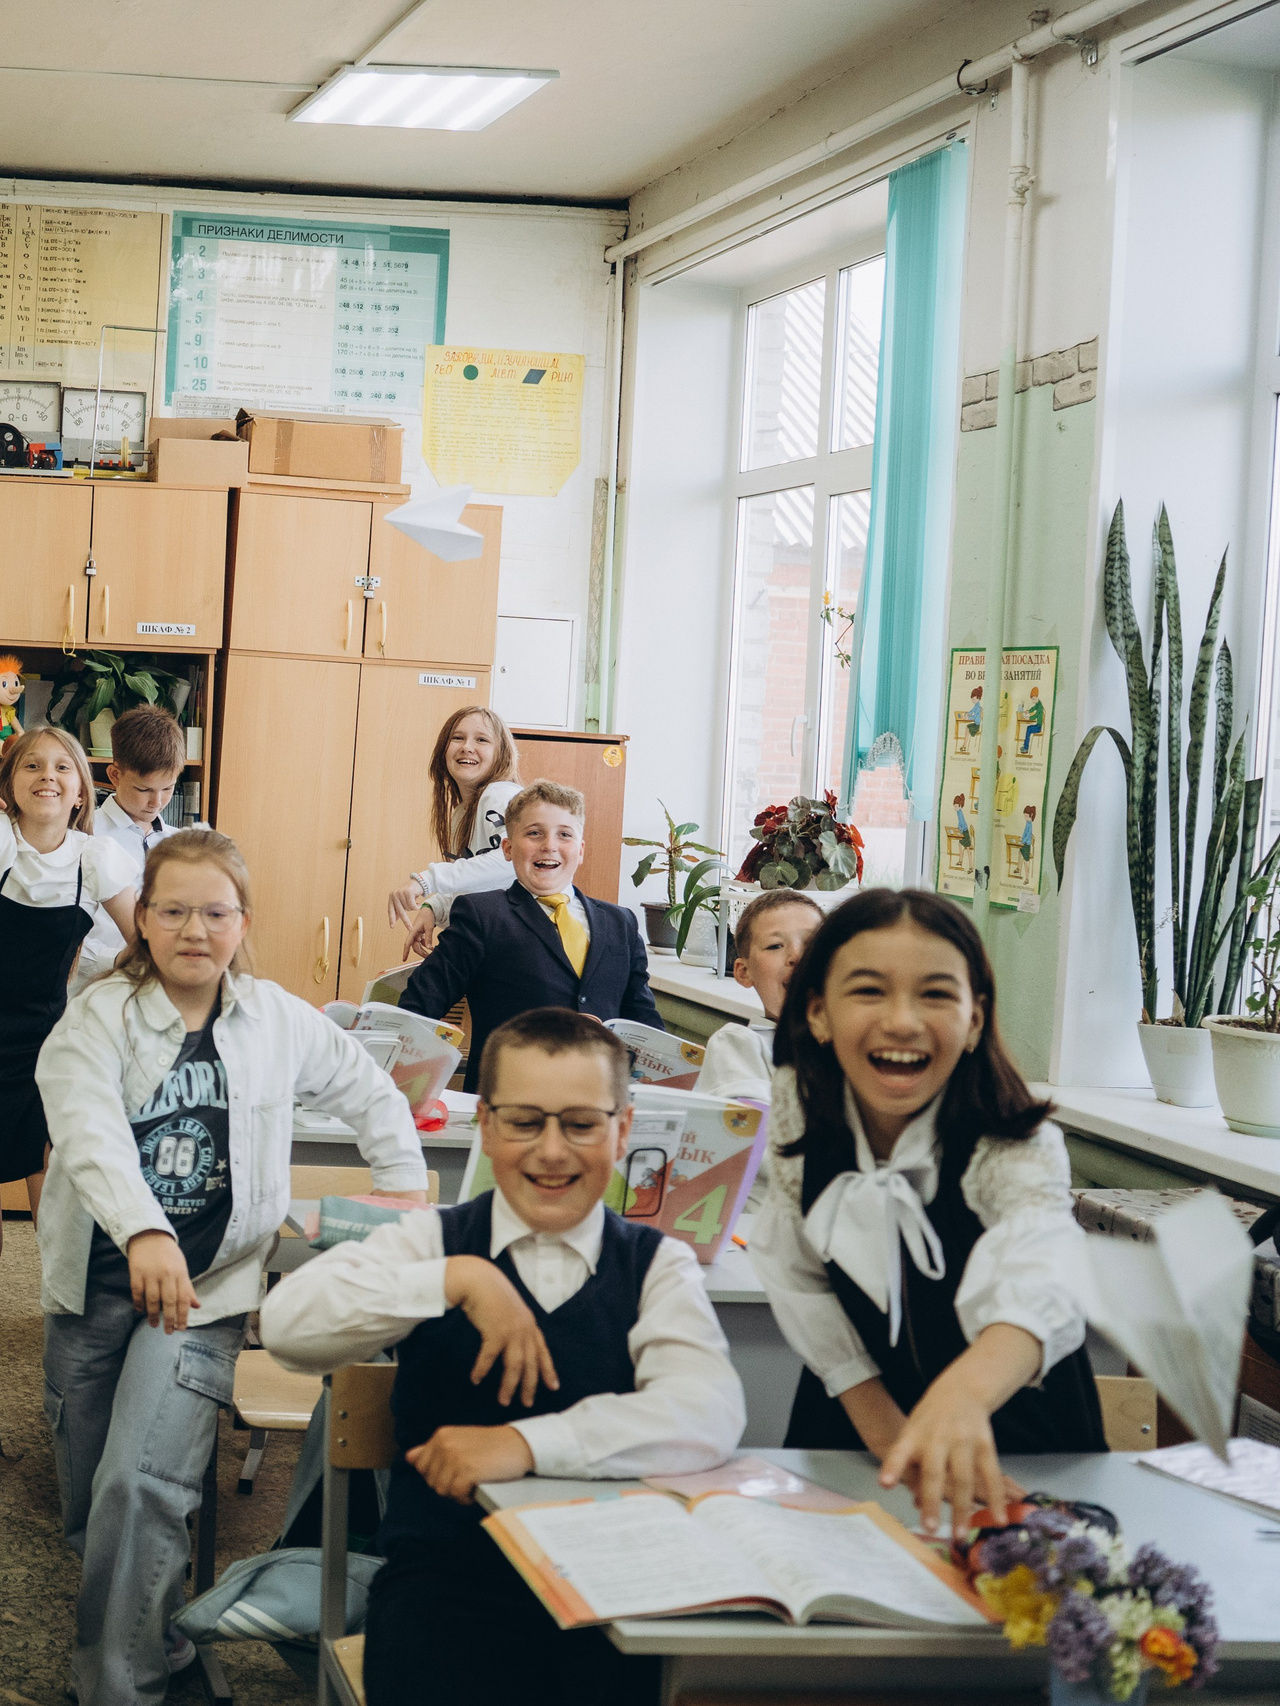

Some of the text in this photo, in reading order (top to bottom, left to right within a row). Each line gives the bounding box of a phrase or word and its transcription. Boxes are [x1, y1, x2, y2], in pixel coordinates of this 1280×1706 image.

[198, 225, 344, 244] ПРИЗНАКИ ДЕЛИМОСТИ
[199, 245, 206, 258] 2
[198, 268, 205, 279] 3
[197, 290, 204, 301] 4
[195, 312, 202, 324] 5
[195, 334, 202, 346] 9
[194, 357, 208, 369] 10
[192, 379, 207, 391] 25
[142, 625, 173, 633] ШКАФ
[175, 626, 184, 634] №
[1012, 655, 1050, 666] ПОСАДКА
[423, 676, 454, 685] ШКАФ
[965, 671, 976, 680] ВО
[1004, 669, 1042, 681] ЗАНЯТИЙ
[142, 1119, 207, 1156] DREAM TEAM
[156, 1136, 196, 1177] 88
[182, 1147, 213, 1191] COLLEGE
[673, 1184, 729, 1244] 4
